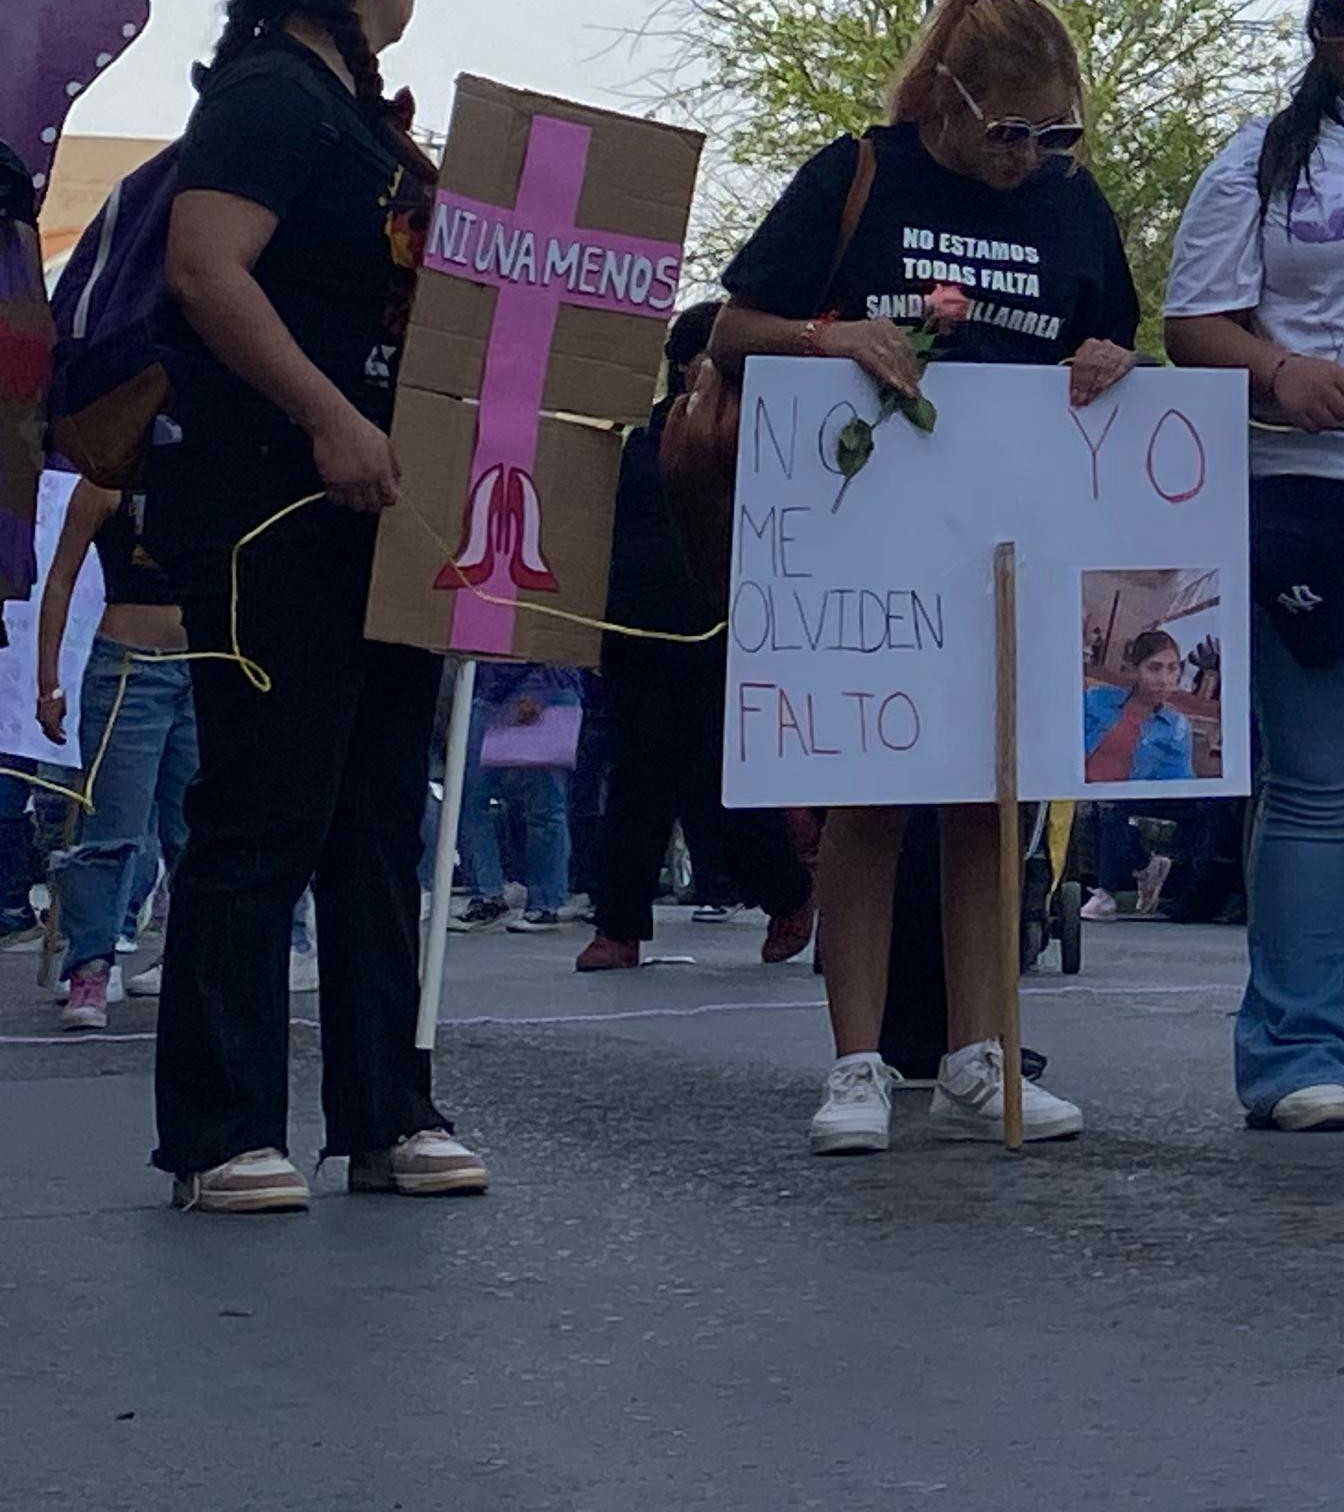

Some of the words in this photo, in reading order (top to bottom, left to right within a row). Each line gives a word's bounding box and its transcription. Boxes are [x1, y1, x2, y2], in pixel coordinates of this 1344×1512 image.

[427, 203, 477, 266] NI
[474, 218, 537, 285] UNA
[541, 238, 681, 310] MENOS
[902, 258, 976, 287] TODAS
[980, 269, 1040, 298] FALTA
[903, 227, 934, 250] NO
[939, 233, 1040, 264] ESTAMOS
[866, 294, 928, 319] SAND
[1069, 405, 1205, 503] YO
[738, 505, 812, 578] ME
[730, 580, 944, 654] OLVIDEN
[739, 681, 921, 763] FALTO
